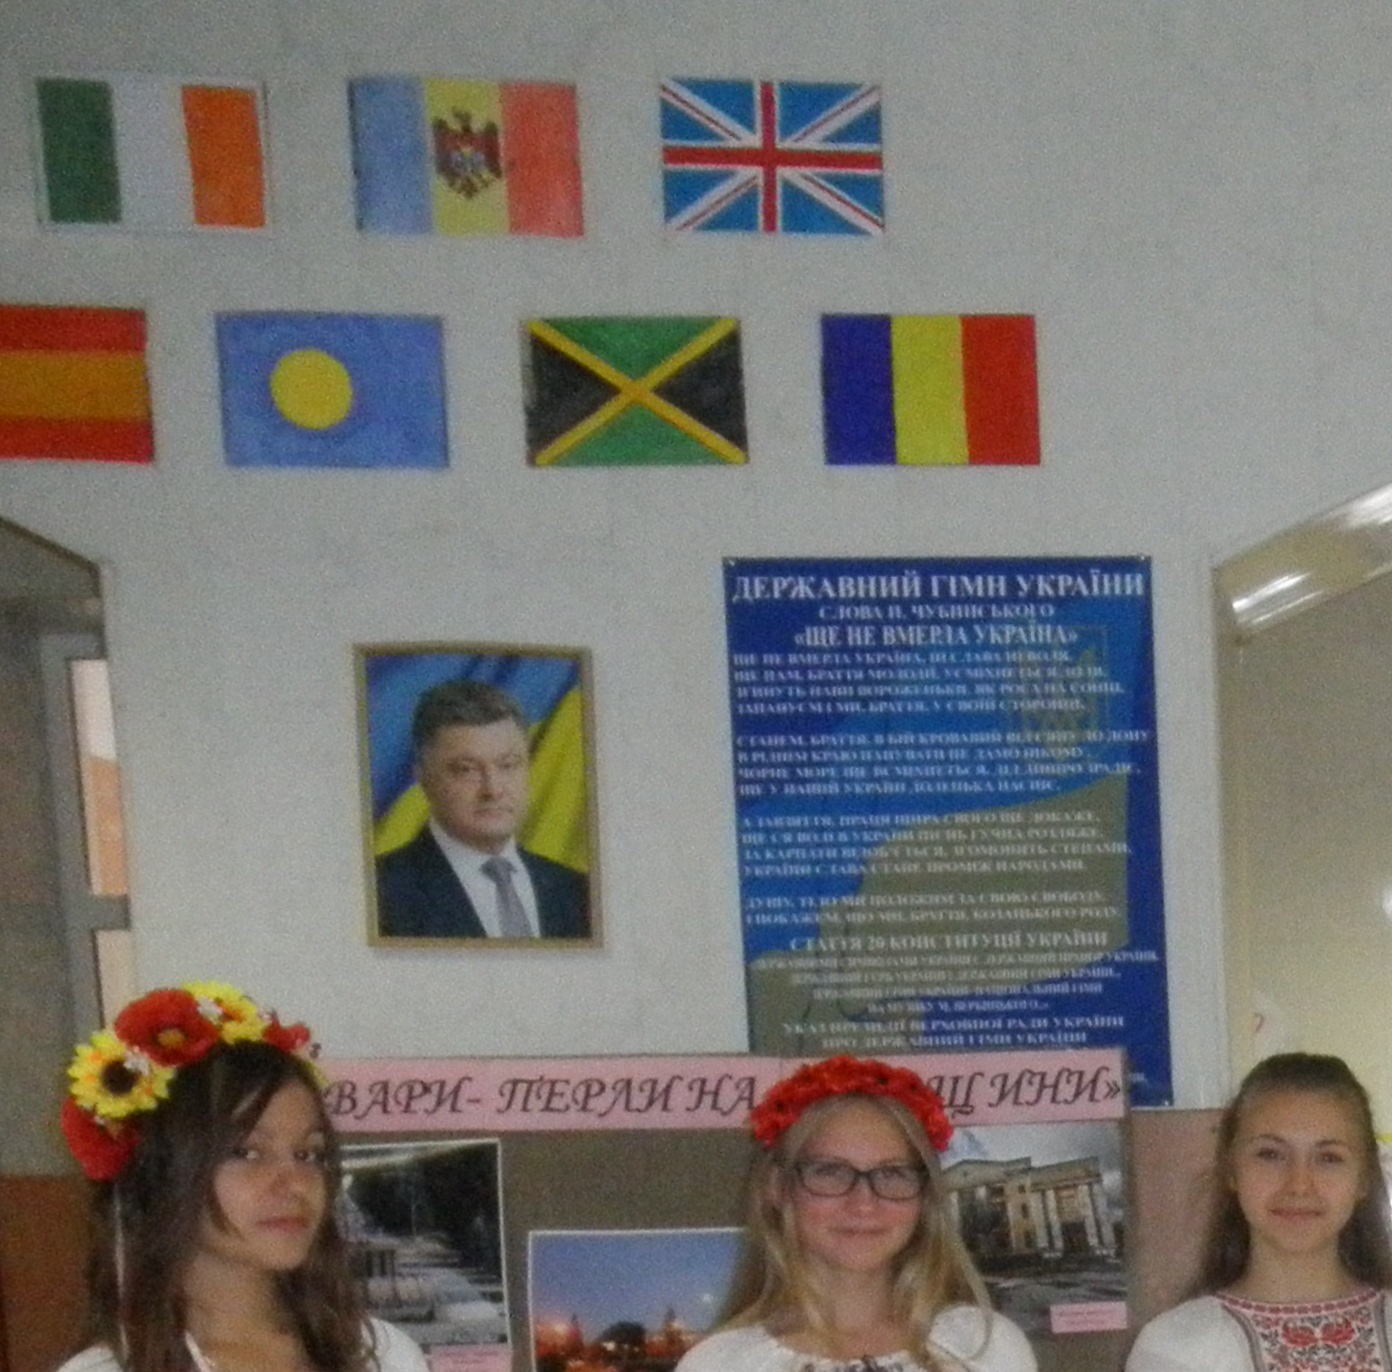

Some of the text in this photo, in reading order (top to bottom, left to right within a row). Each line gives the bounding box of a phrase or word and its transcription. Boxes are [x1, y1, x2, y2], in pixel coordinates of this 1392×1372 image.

[732, 568, 1145, 603] ДЕРЖАВНИЙ ГІМН УКРАЇНИ
[847, 624, 877, 647] НЕ
[882, 622, 969, 647] ВМЕРЛА
[495, 1073, 757, 1118] ПЕРЛИНА
